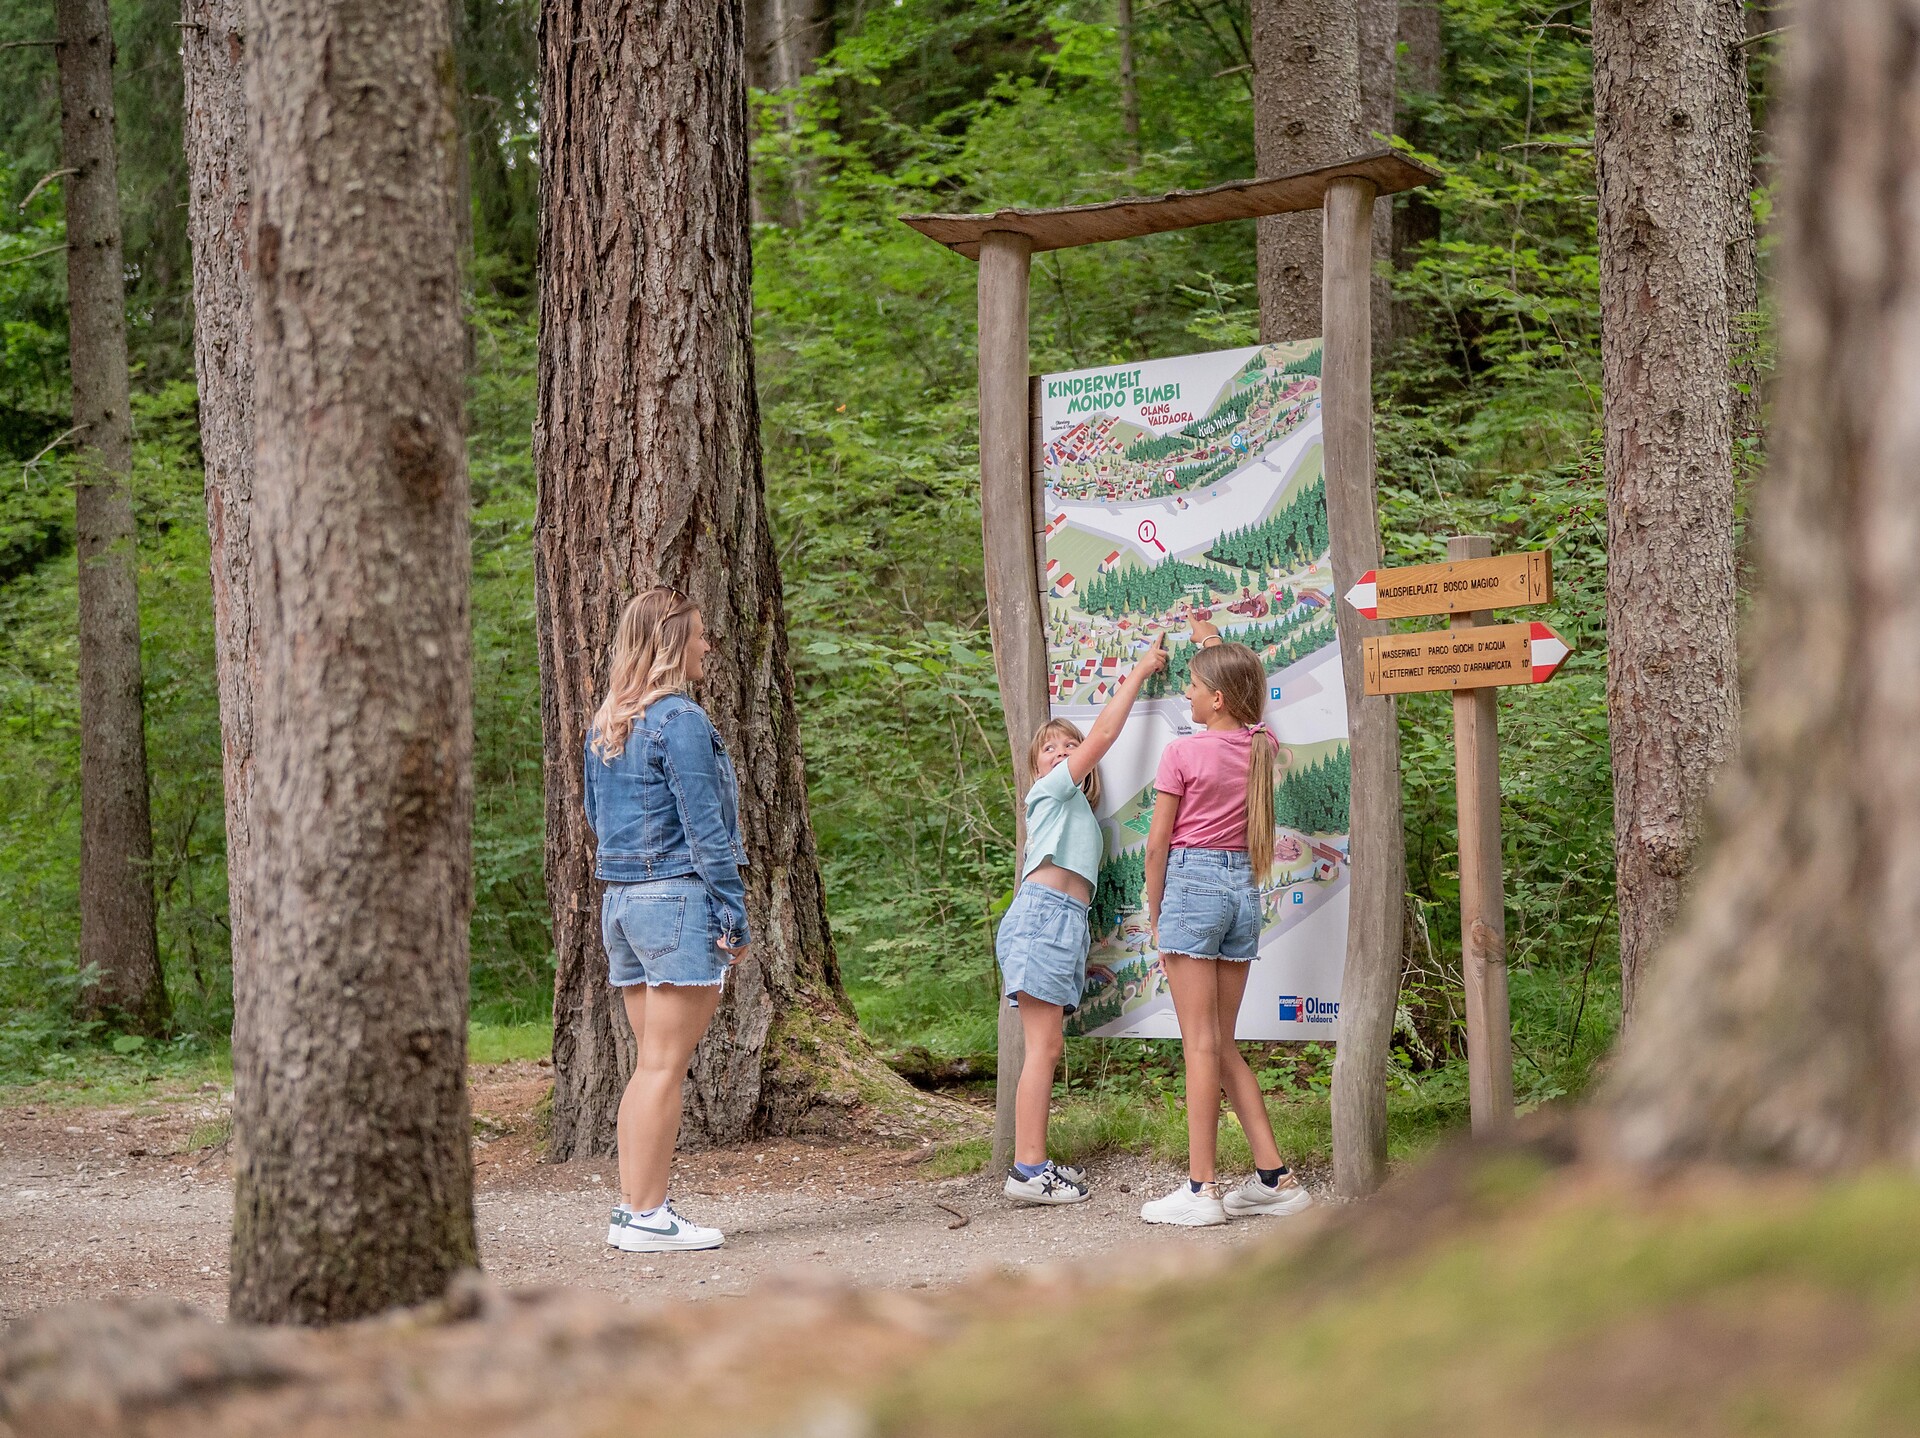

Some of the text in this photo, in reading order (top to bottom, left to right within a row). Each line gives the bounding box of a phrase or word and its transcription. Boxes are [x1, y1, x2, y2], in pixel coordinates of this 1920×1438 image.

[1049, 370, 1141, 398] KINDERWELT
[1067, 383, 1181, 414] MONDO BIMBI
[1141, 404, 1170, 416] OLANG
[1148, 412, 1194, 426] VALDAORA
[1198, 411, 1238, 437] Kids World
[1534, 558, 1539, 572] T
[1379, 584, 1438, 599] WALDSPIELPLATZ
[1443, 580, 1468, 592] BOSCO
[1471, 577, 1499, 589] MAGICO
[1534, 583, 1541, 596] V
[1369, 648, 1374, 660] T
[1382, 648, 1421, 659] WASSERWELT
[1429, 645, 1448, 655] PARCO
[1453, 643, 1474, 653] GIOCHI
[1478, 641, 1506, 651] D'ACQUA
[1382, 667, 1424, 679] KLETTERWELT
[1428, 664, 1461, 675] PERCORSO
[1464, 660, 1512, 672] D'ARRAMPICATA
[1369, 671, 1376, 684] V
[1306, 1014, 1333, 1023] Valdaora
